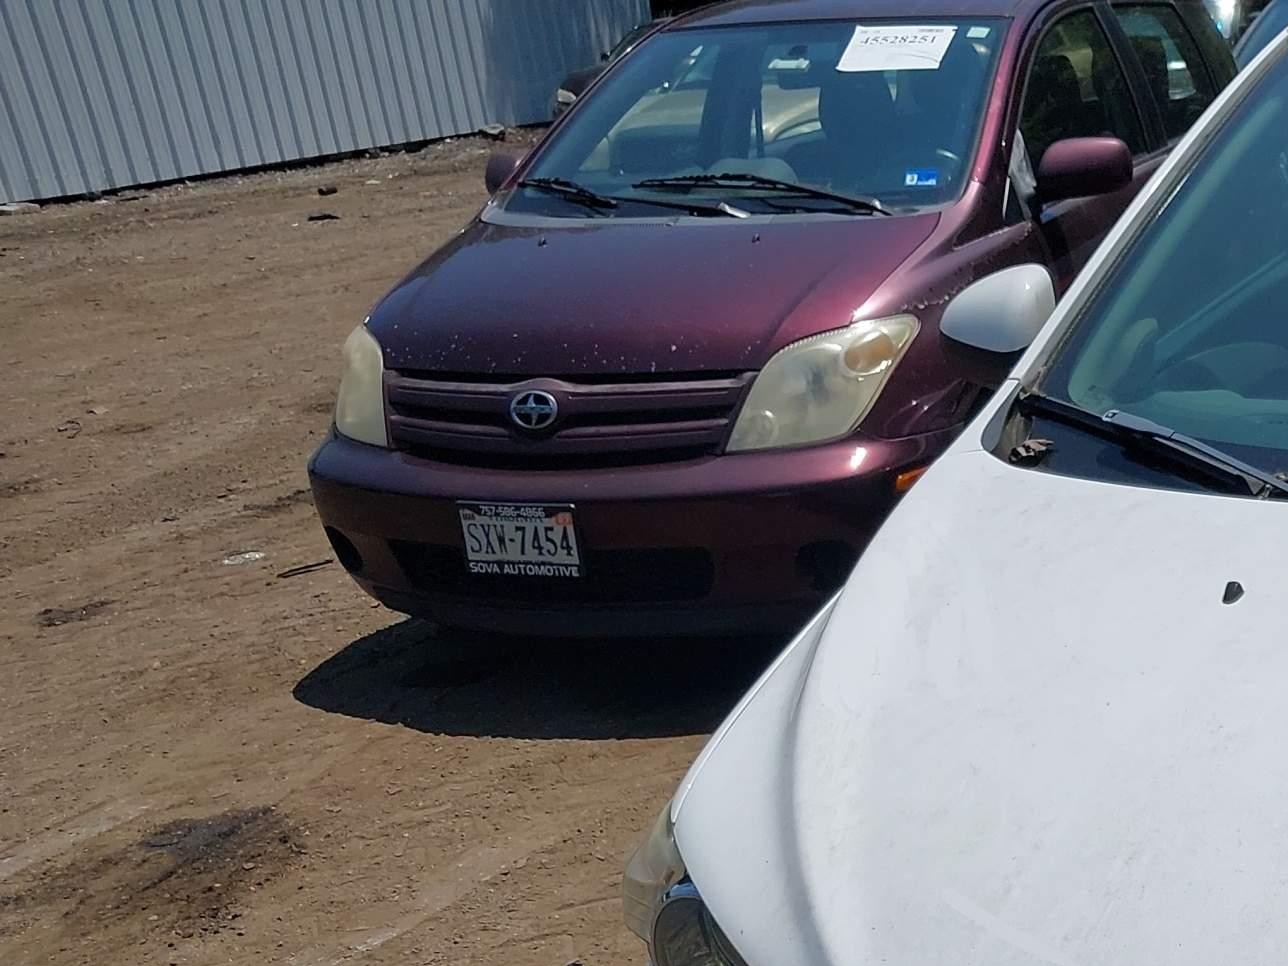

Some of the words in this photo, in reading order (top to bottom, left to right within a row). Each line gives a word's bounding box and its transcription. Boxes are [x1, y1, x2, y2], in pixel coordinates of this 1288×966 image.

[860, 35, 936, 45] 45528251
[467, 523, 574, 557] SXW-7454
[469, 562, 500, 574] SOVA
[503, 563, 580, 577] AUTOMOTIVE
